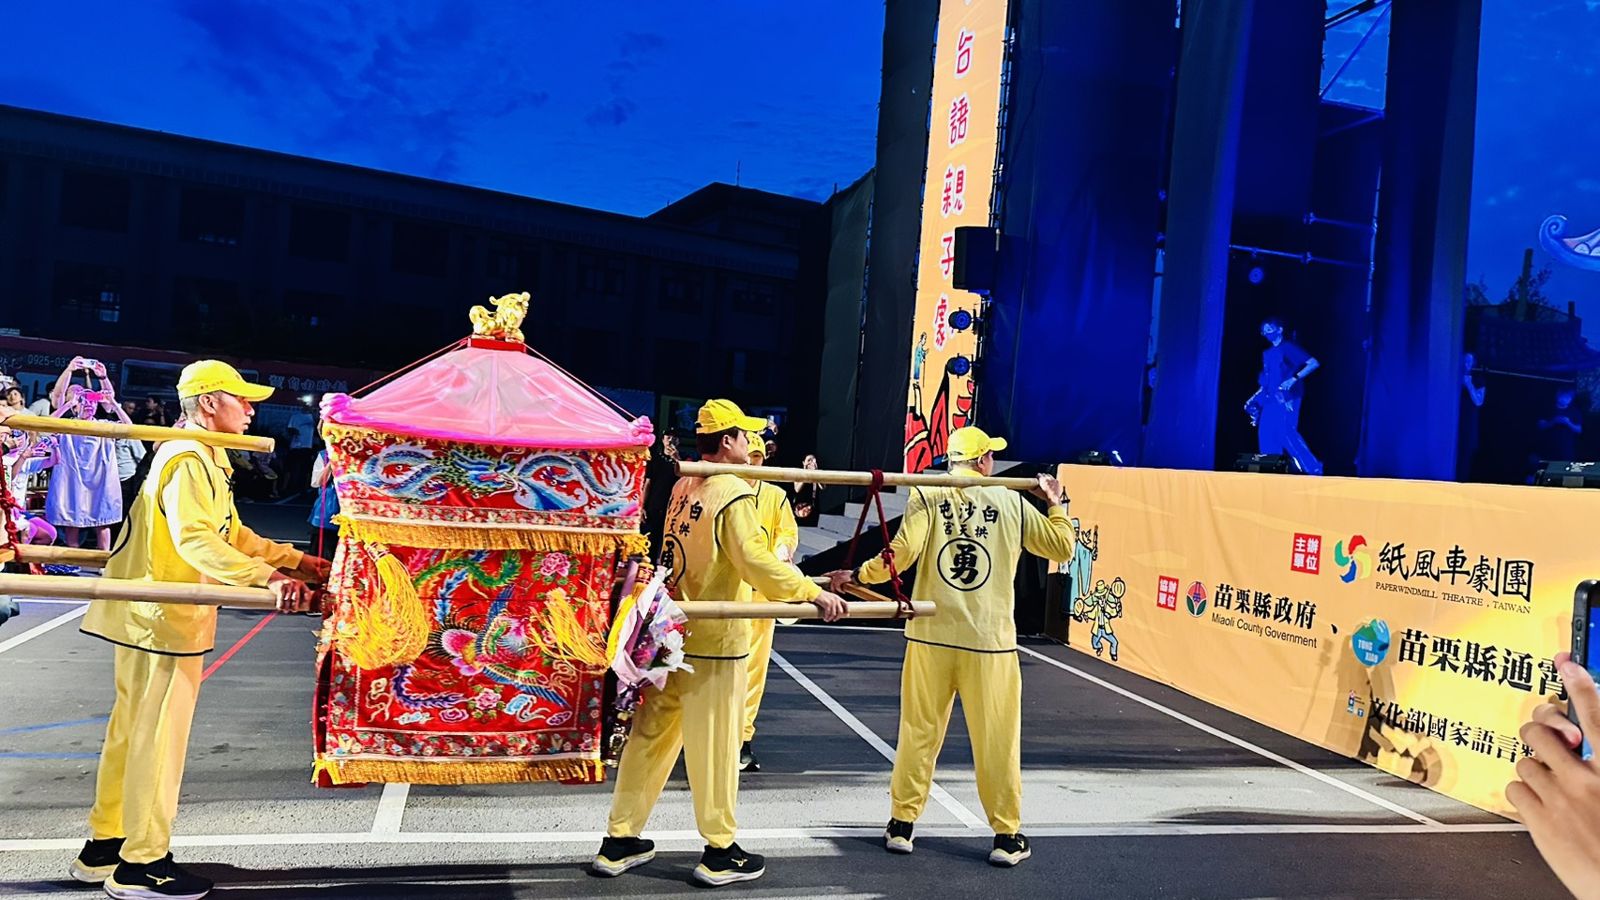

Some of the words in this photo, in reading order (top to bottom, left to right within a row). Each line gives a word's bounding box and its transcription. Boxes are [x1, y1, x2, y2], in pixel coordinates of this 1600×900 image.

[949, 543, 979, 585] 勇
[1376, 541, 1535, 603] 紙風車劇團
[1375, 581, 1438, 599] PAPERWINDMILL
[1442, 592, 1484, 607] THEATRE
[1493, 600, 1532, 614] TAIWAN
[1212, 612, 1235, 628] Miaoli
[1237, 618, 1263, 637] County
[1264, 624, 1318, 649] Government
[1368, 697, 1536, 763] 文化部國家語言
